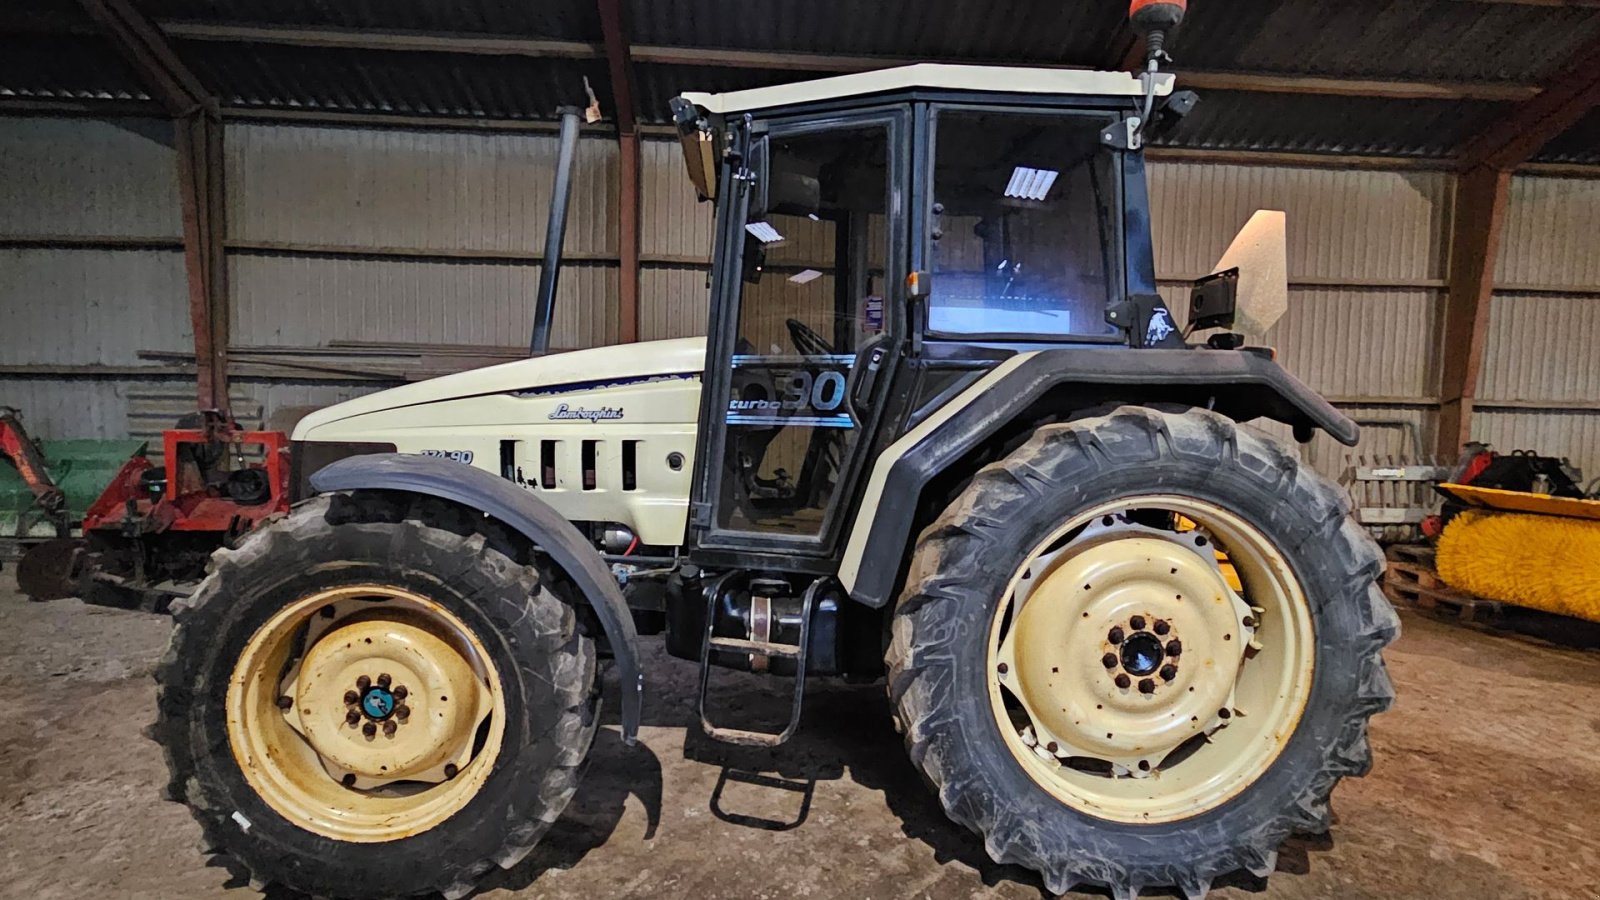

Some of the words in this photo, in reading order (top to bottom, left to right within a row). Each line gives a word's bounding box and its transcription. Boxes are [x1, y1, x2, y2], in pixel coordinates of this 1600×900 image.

[729, 399, 781, 410] turbo
[782, 370, 846, 411] 90
[548, 403, 624, 423] Lamborghini
